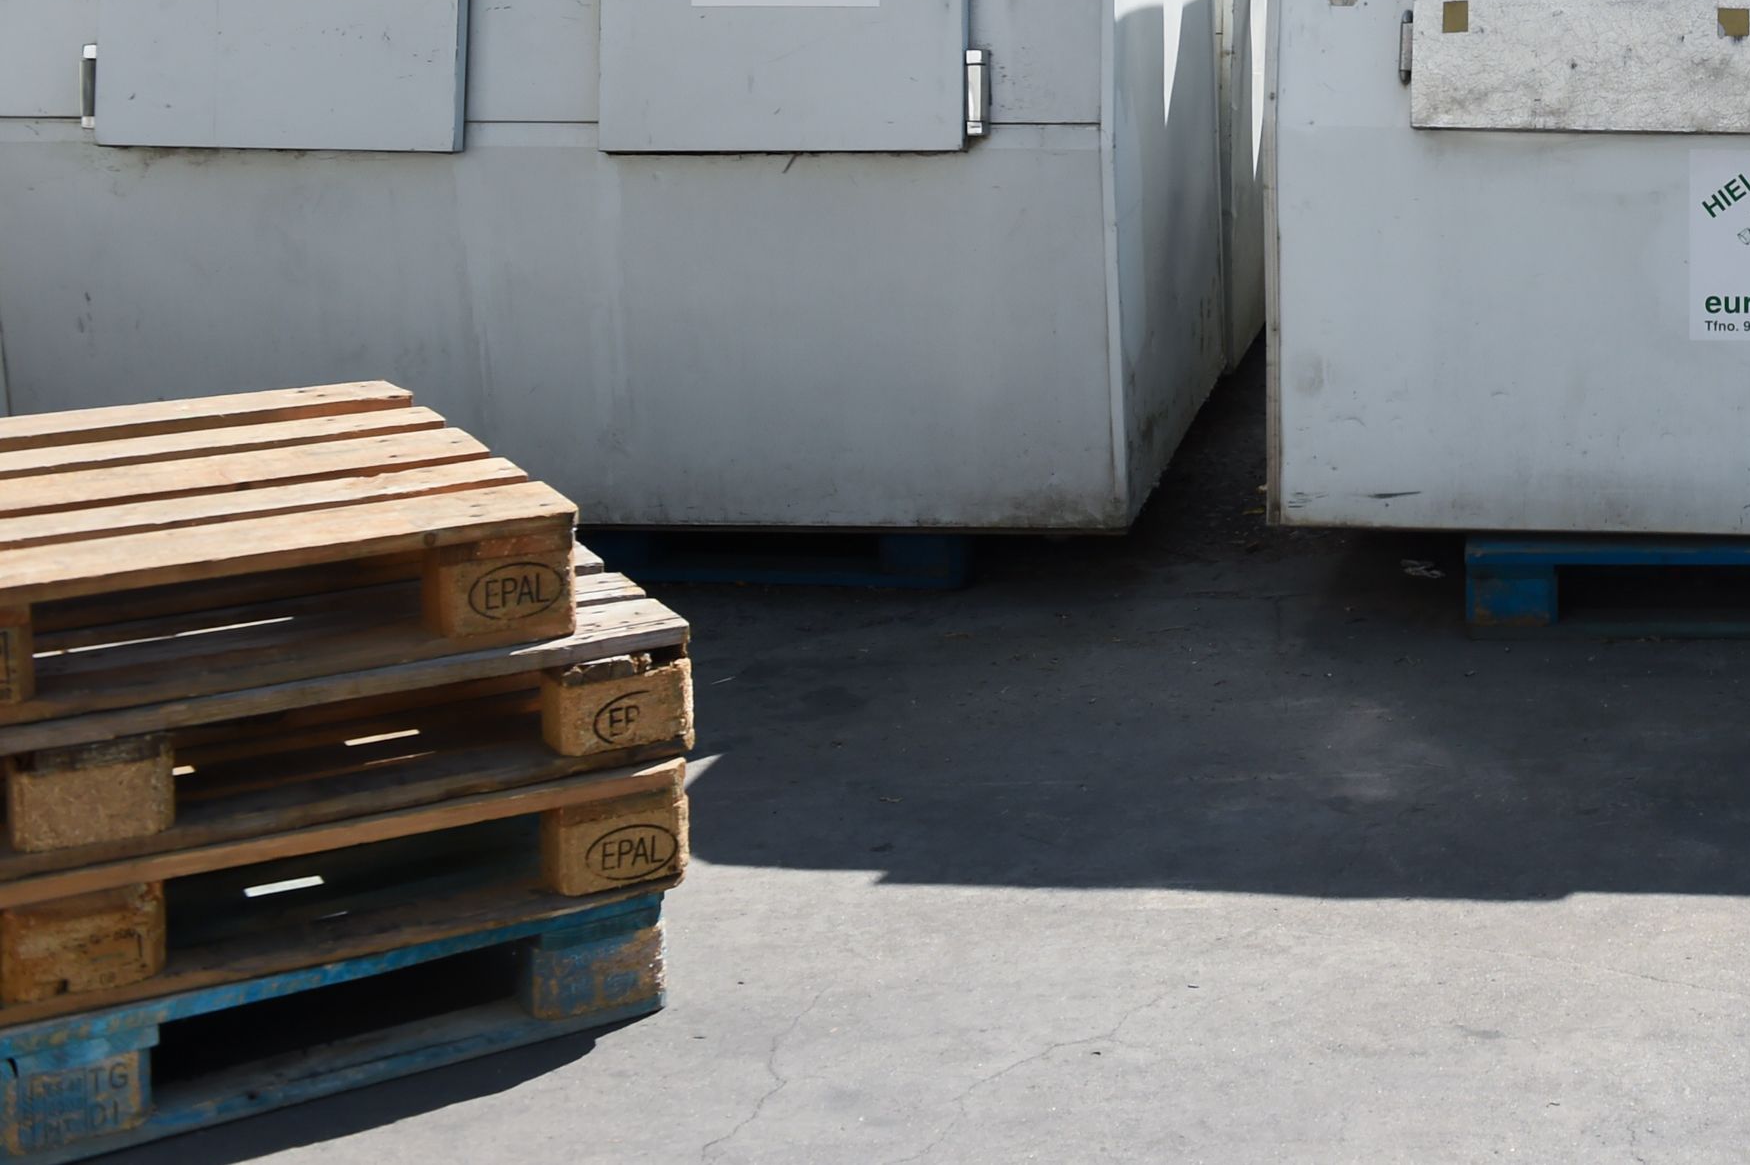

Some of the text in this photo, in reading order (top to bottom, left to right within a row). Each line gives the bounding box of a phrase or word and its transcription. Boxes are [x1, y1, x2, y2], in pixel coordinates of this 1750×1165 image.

[1704, 321, 1739, 332] Tfno.
[484, 572, 549, 611] EPAL
[601, 835, 664, 871] EPAL
